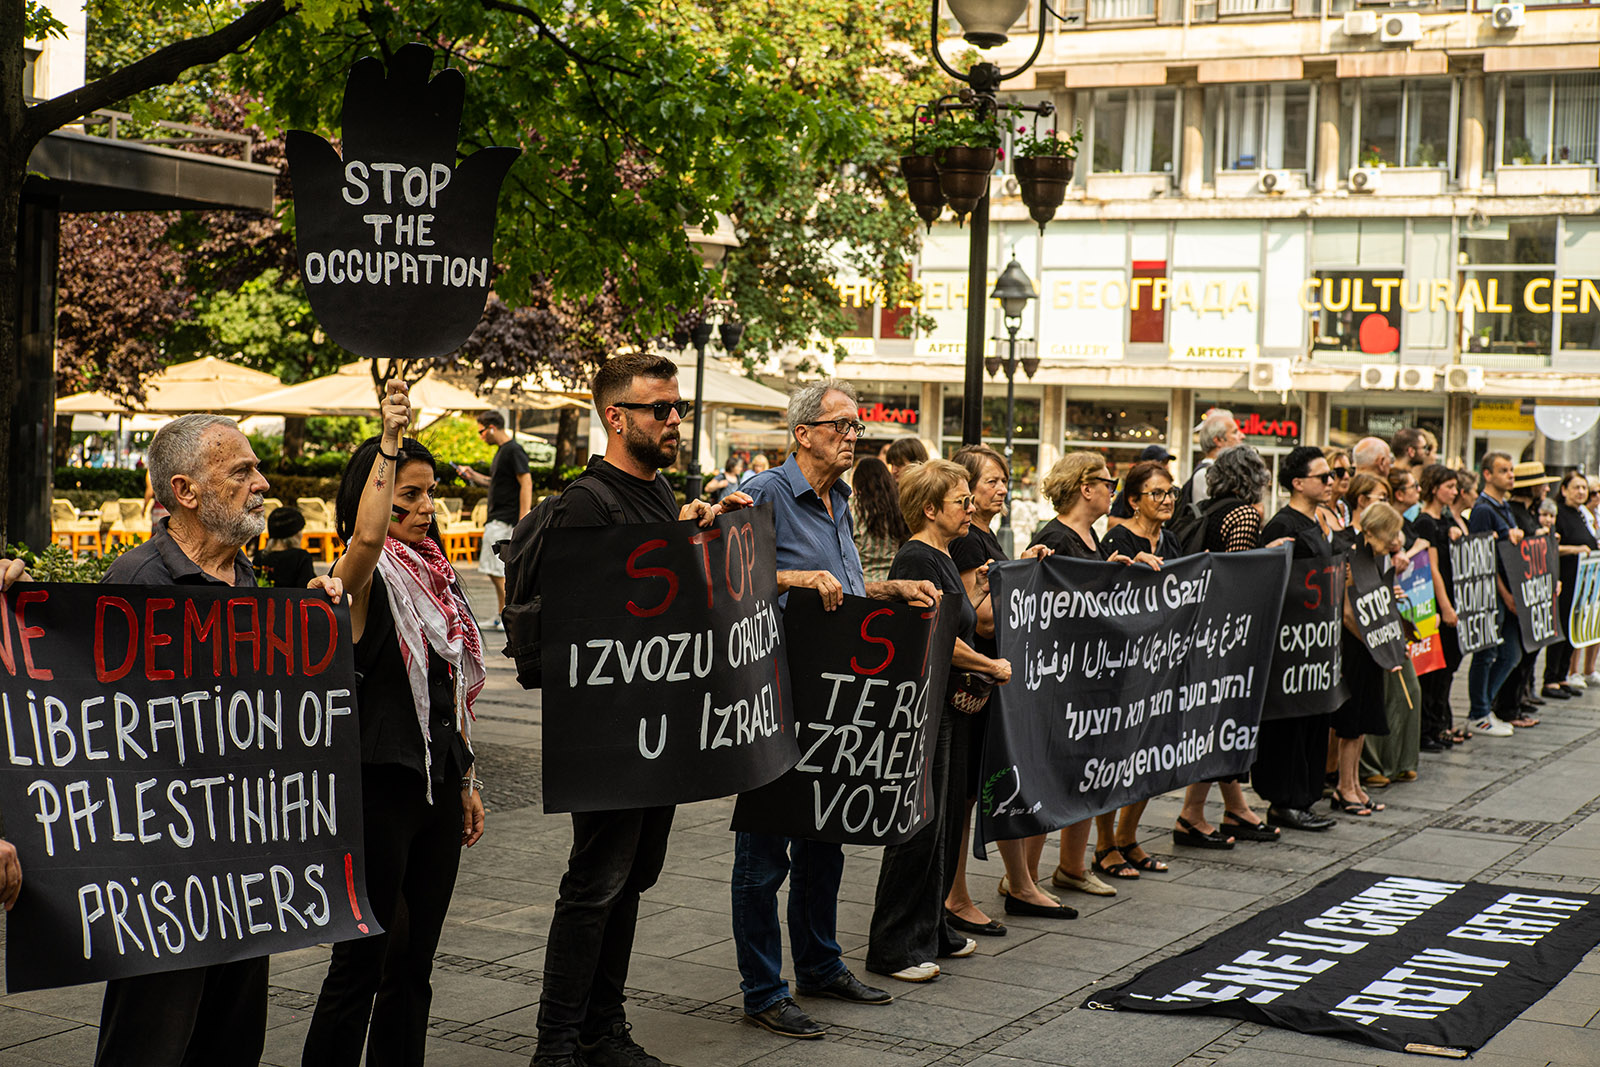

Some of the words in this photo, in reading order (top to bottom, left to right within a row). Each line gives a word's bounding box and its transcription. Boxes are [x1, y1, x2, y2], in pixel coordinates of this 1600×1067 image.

[341, 160, 451, 208] STOP
[363, 214, 436, 246] THE
[305, 249, 488, 288] OCCUPATION
[1052, 278, 1258, 318] БЕОГРАДА
[1300, 277, 1512, 314] CULTURAL
[929, 343, 966, 353] АРТГ
[1186, 346, 1245, 359] ARTGET
[858, 403, 916, 423] ulkan
[626, 521, 755, 618] STOP
[1520, 537, 1548, 579] STOP
[1009, 588, 1037, 633] Stop
[1040, 581, 1141, 630] genocidu
[1144, 585, 1158, 612] u
[1162, 569, 1212, 609] Gazi!
[1356, 586, 1391, 627] STOP
[1416, 600, 1432, 618] PACE
[94, 594, 339, 683] DEMAND
[569, 629, 713, 688] IZVOZU
[1411, 637, 1432, 657] PEACE
[821, 665, 931, 729] TERO
[1282, 661, 1330, 694] arms
[299, 689, 352, 749] OF
[638, 714, 668, 760] U
[1078, 756, 1127, 793] Stop
[1304, 876, 1466, 936] CRNOM
[1447, 893, 1590, 946] RATA
[1267, 931, 1370, 954] U
[1130, 950, 1339, 1004] ENE
